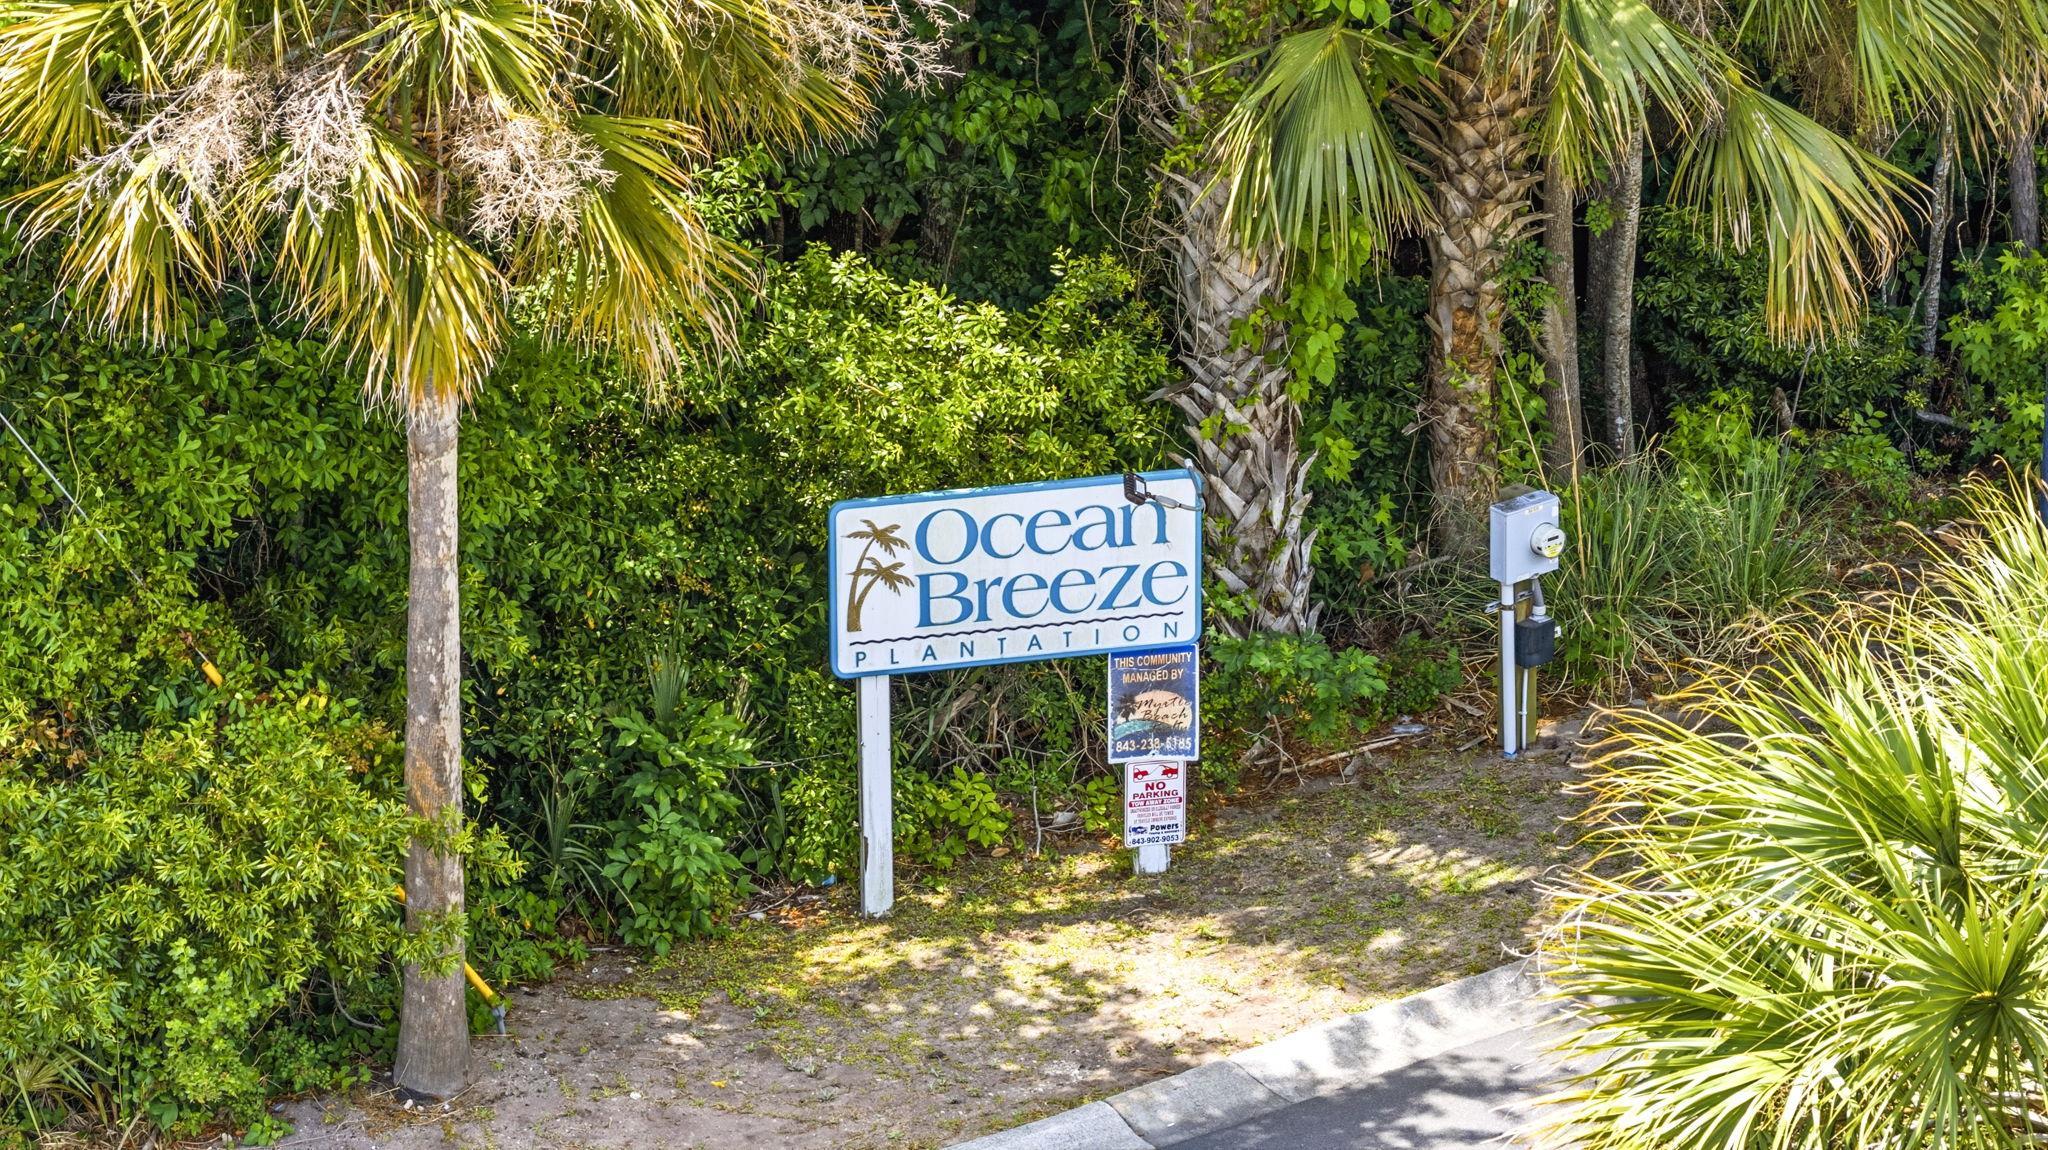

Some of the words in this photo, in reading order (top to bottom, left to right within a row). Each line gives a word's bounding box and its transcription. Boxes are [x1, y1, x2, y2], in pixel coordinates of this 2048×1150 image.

[915, 499, 1169, 565] Ocean
[915, 560, 1189, 628] Breeze
[855, 621, 1178, 667] PLANTATION
[1114, 656, 1135, 669] THIS
[1136, 652, 1192, 667] COMMUNITY
[1122, 670, 1168, 684] MANAGED
[1171, 669, 1184, 680] BY
[1141, 707, 1188, 720] Beach
[1145, 781, 1166, 792] NO
[1132, 790, 1179, 800] PARKING
[1145, 798, 1162, 806] AWAY
[1150, 823, 1179, 831] Powers
[1132, 834, 1179, 845] 843-902-9053
